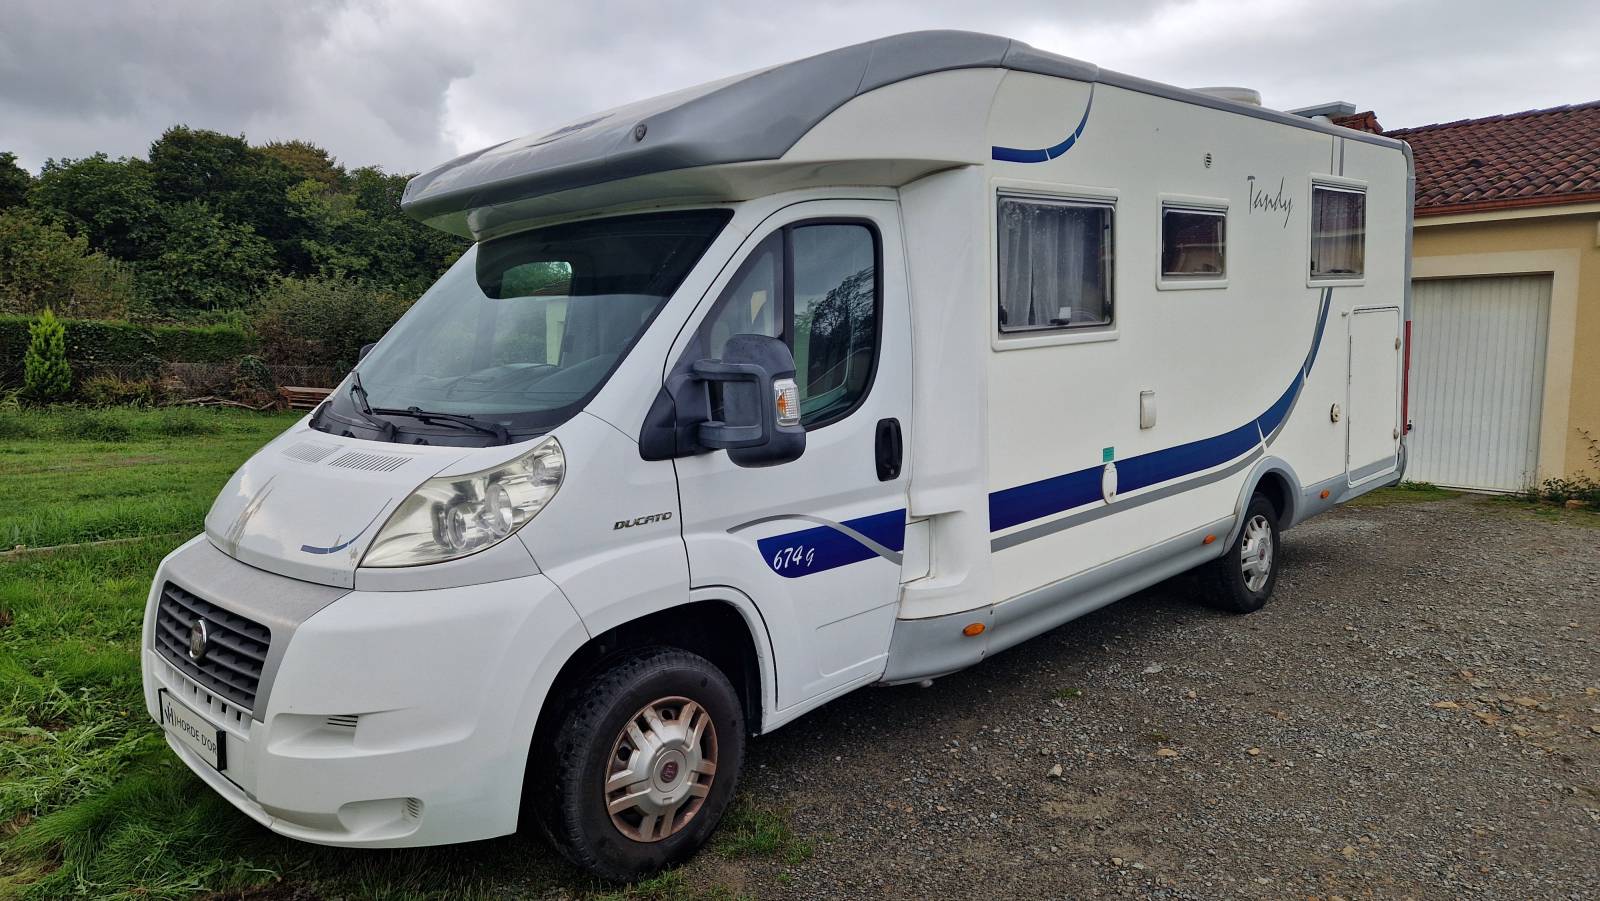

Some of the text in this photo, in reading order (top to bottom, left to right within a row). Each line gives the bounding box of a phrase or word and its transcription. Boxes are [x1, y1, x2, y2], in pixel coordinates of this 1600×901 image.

[1247, 175, 1292, 229] Tandy
[613, 512, 673, 530] DUCATO
[176, 717, 200, 742] HORDE
